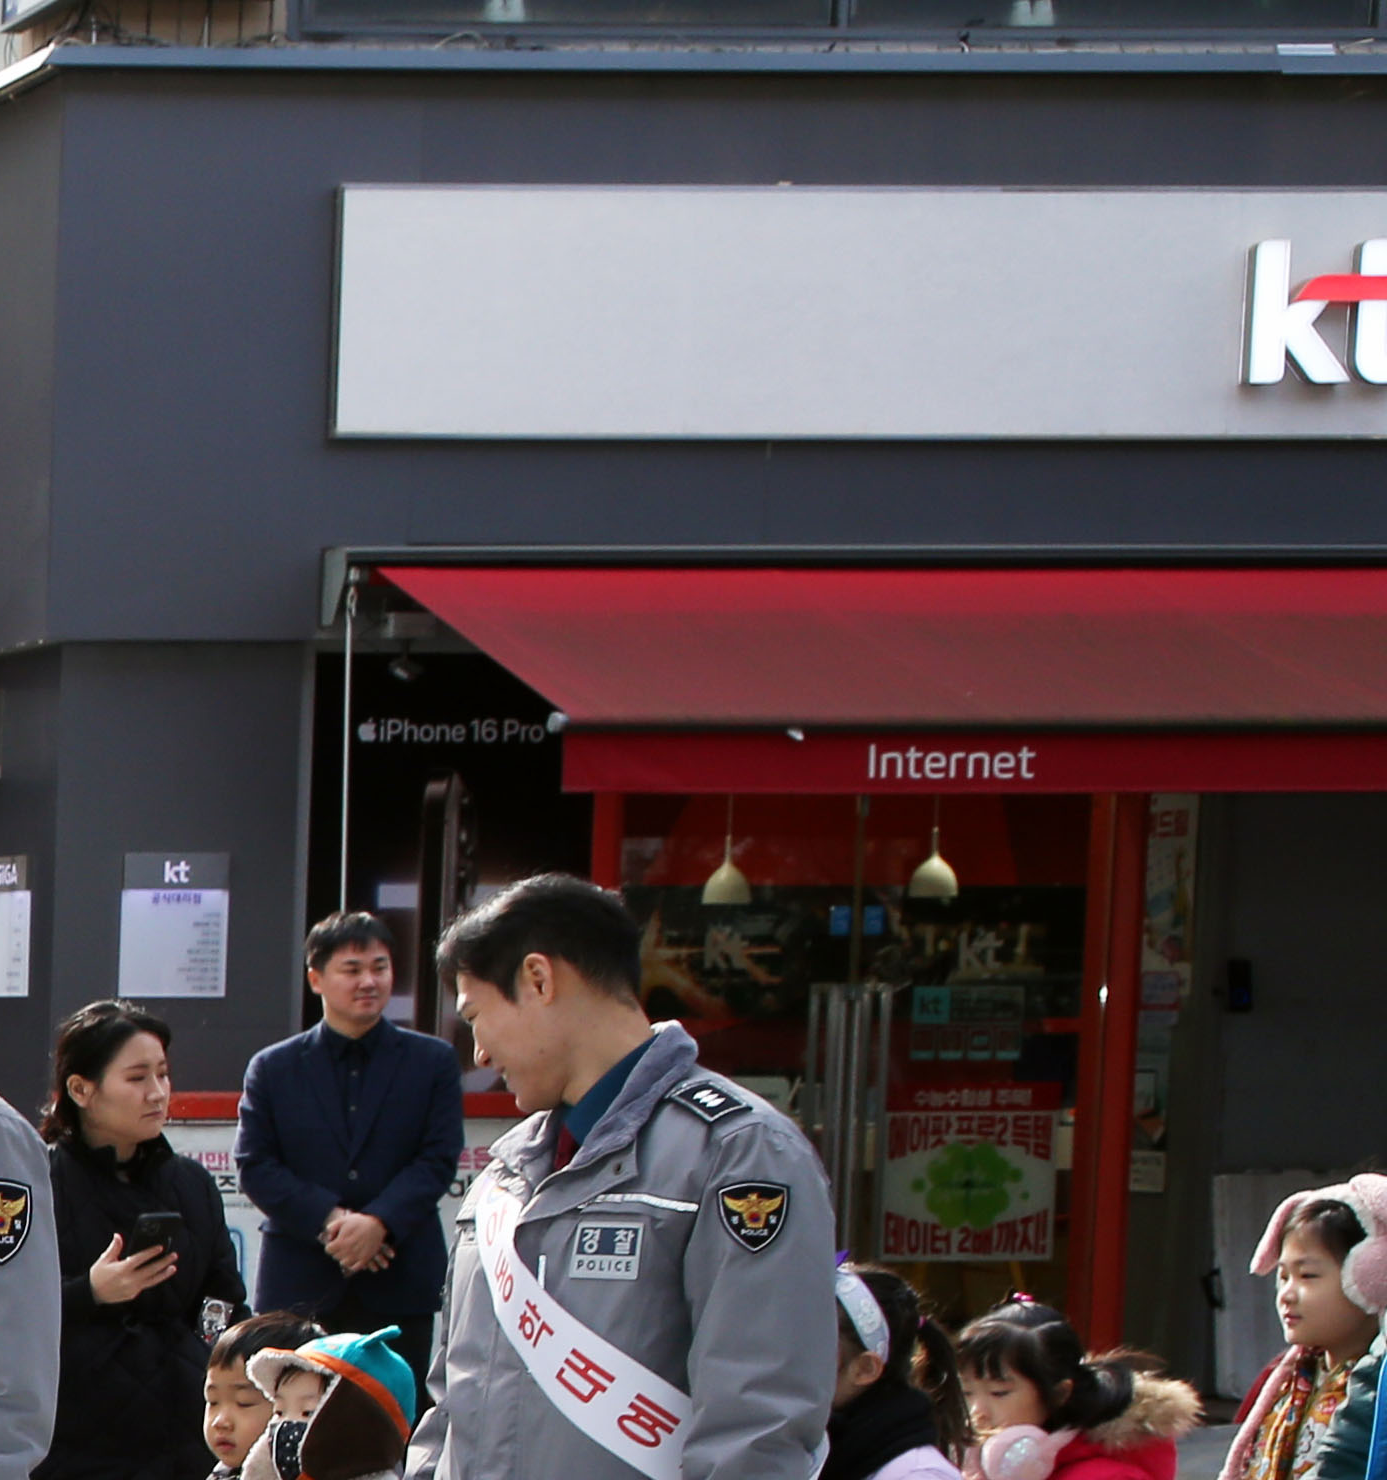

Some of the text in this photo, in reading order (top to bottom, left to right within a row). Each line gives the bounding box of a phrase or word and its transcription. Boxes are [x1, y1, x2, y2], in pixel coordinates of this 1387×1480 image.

[378, 718, 545, 742] iPhone 16 Pro
[867, 744, 1037, 780] Internet
[164, 861, 191, 883] kt
[581, 1229, 636, 1255] 경찰
[740, 1228, 769, 1237] POLICE
[575, 1259, 633, 1273] POLICE
